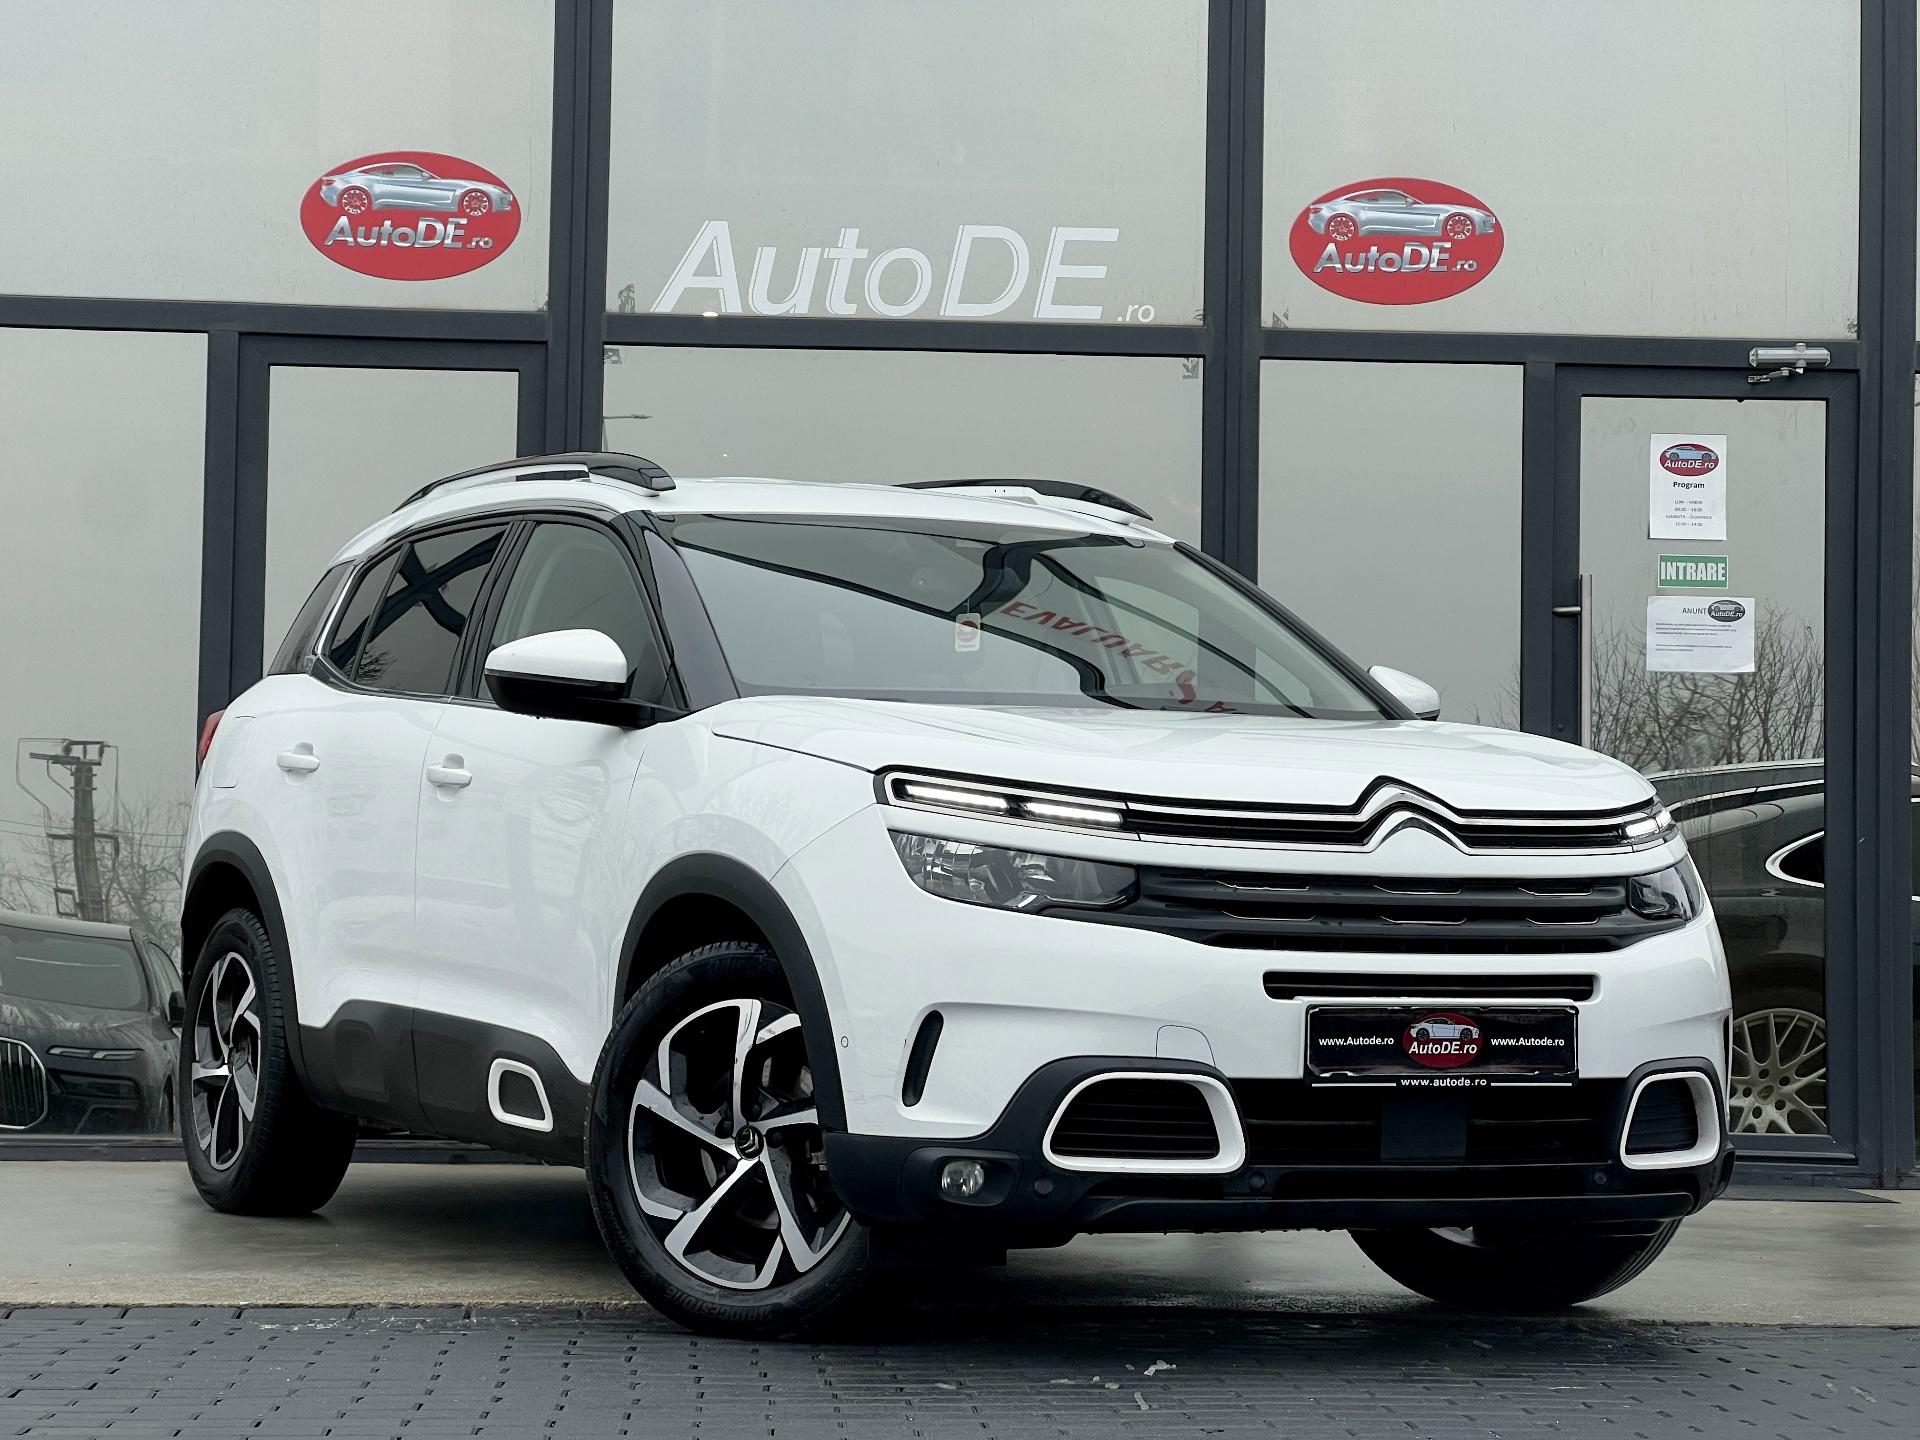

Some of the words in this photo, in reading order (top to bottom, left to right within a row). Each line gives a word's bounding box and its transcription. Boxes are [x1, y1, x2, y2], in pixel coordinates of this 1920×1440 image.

[1663, 459, 1715, 469] AutoDE.ro
[1672, 480, 1705, 490] Program
[1660, 561, 1726, 582] INTRARE
[1318, 1036, 1395, 1046] www.Autode.ro
[1490, 1037, 1565, 1047] www.Autode.ro
[1408, 1041, 1478, 1055] AutoDE.ro
[1400, 1077, 1488, 1087] www.autode.ro
